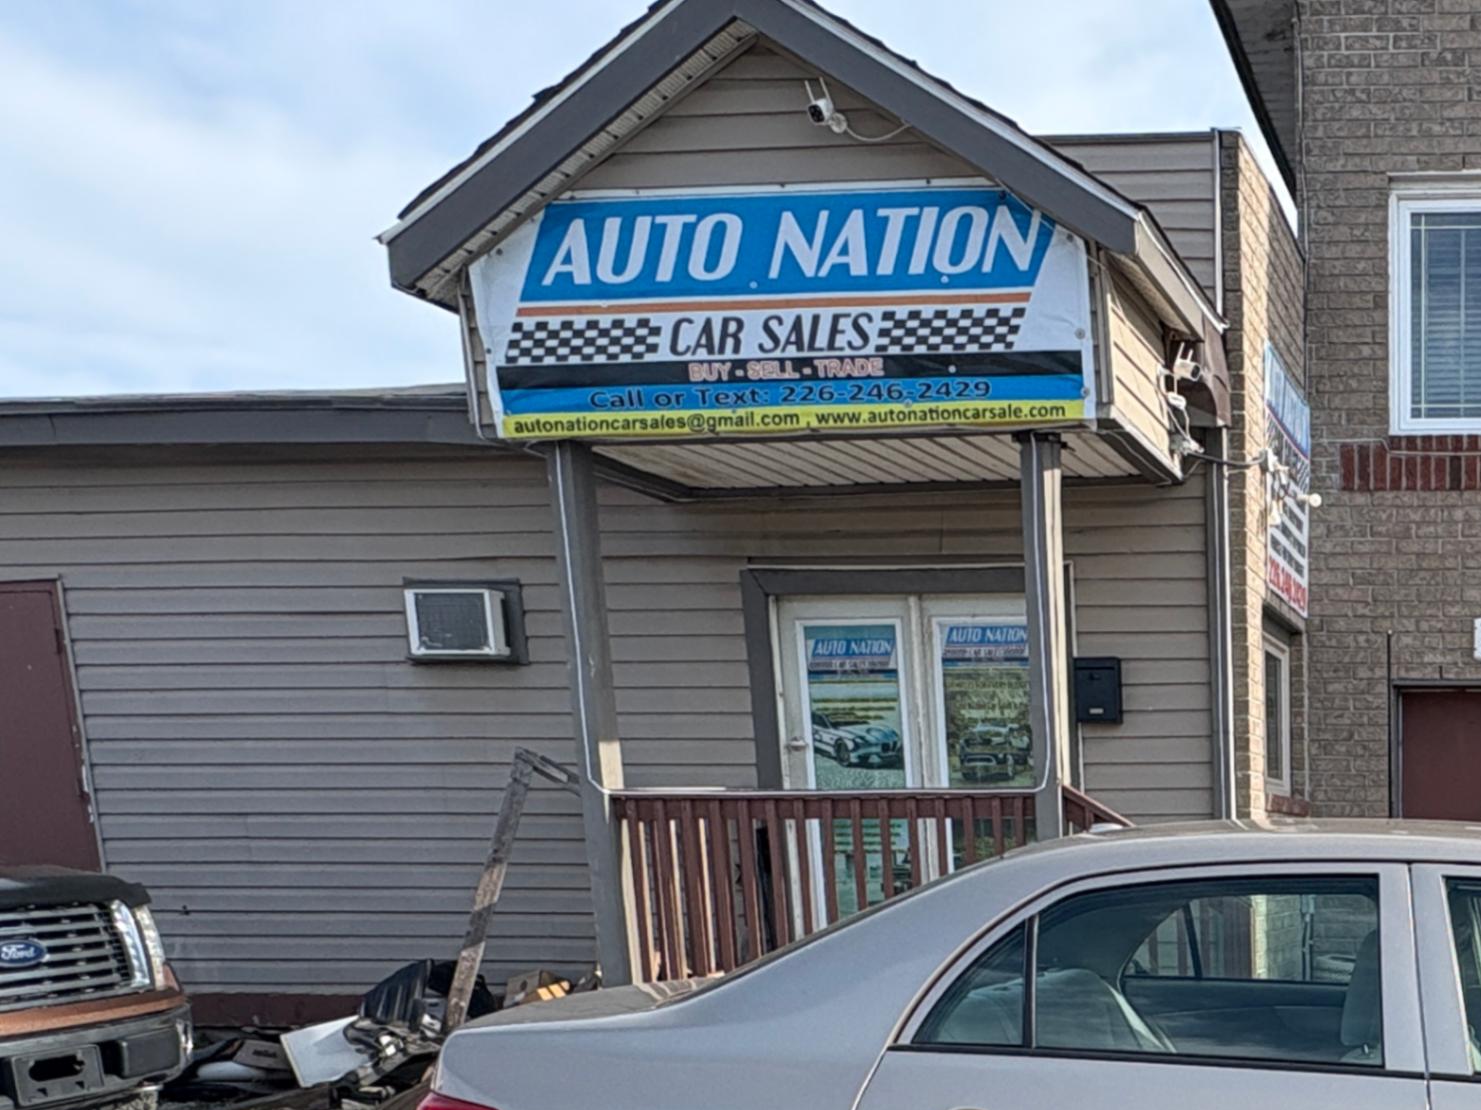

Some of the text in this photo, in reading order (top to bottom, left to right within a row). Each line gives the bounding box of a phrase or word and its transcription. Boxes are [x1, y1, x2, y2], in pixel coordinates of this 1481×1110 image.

[541, 205, 1042, 286] AUTO NATION
[669, 312, 873, 356] CAR SALES
[688, 362, 731, 382] BUY
[747, 360, 800, 380] SELL
[814, 357, 885, 378] TRADE
[590, 380, 991, 409] Call or Text: 226-246-2429
[514, 410, 800, 434] autonationcarsales@gmail.com
[815, 402, 1066, 425] www.autonationcarsale.com
[814, 639, 893, 656] AUTO NATION
[949, 627, 982, 643] AUTO
[1, 943, 36, 960] Ford
